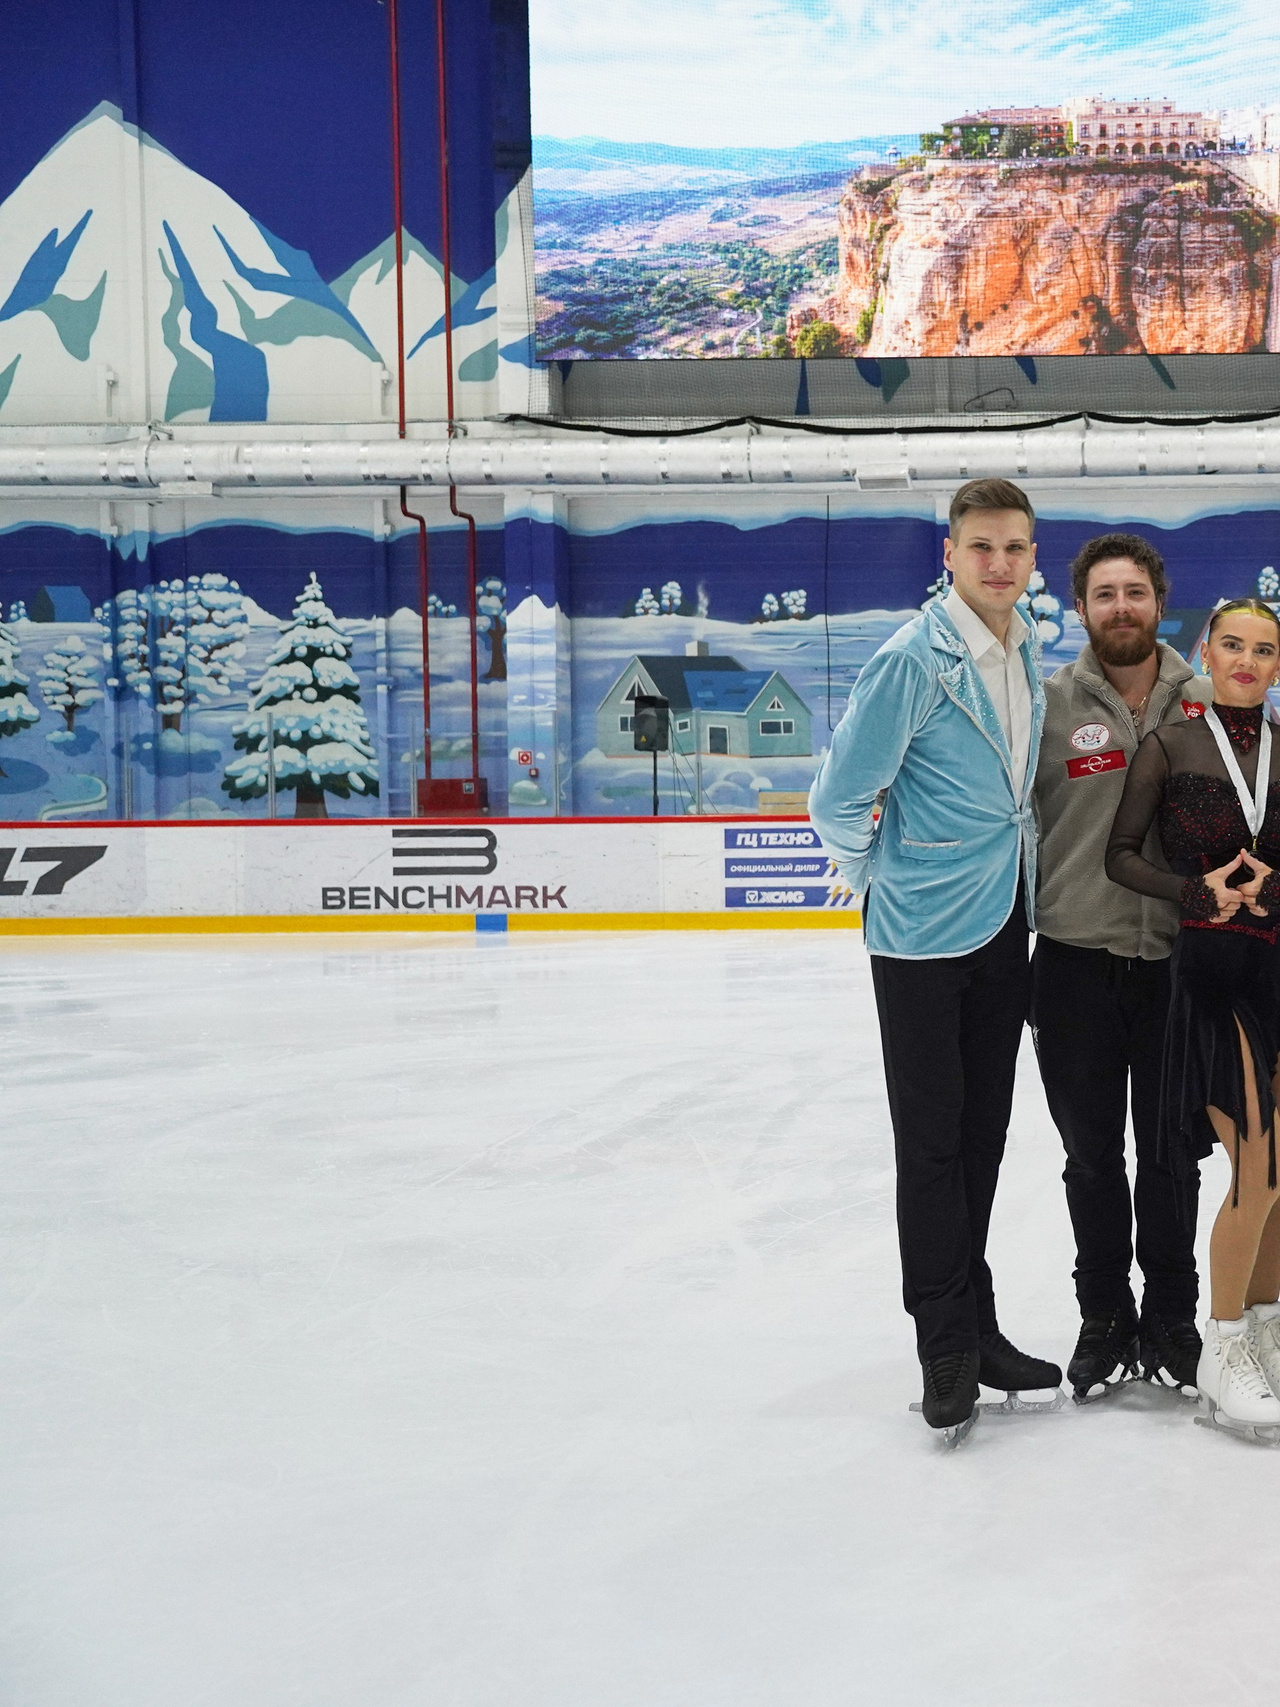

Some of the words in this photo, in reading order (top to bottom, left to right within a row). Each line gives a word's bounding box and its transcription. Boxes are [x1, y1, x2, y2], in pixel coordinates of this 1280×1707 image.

[736, 833, 758, 848] ГЦ
[759, 832, 815, 846] ТЕХНО
[730, 863, 793, 873] ОФИЦИАЛЬНЫЙ
[794, 864, 821, 873] ДИЛЕР
[321, 885, 568, 910] BENCHMARK
[759, 890, 806, 904] XCMG
